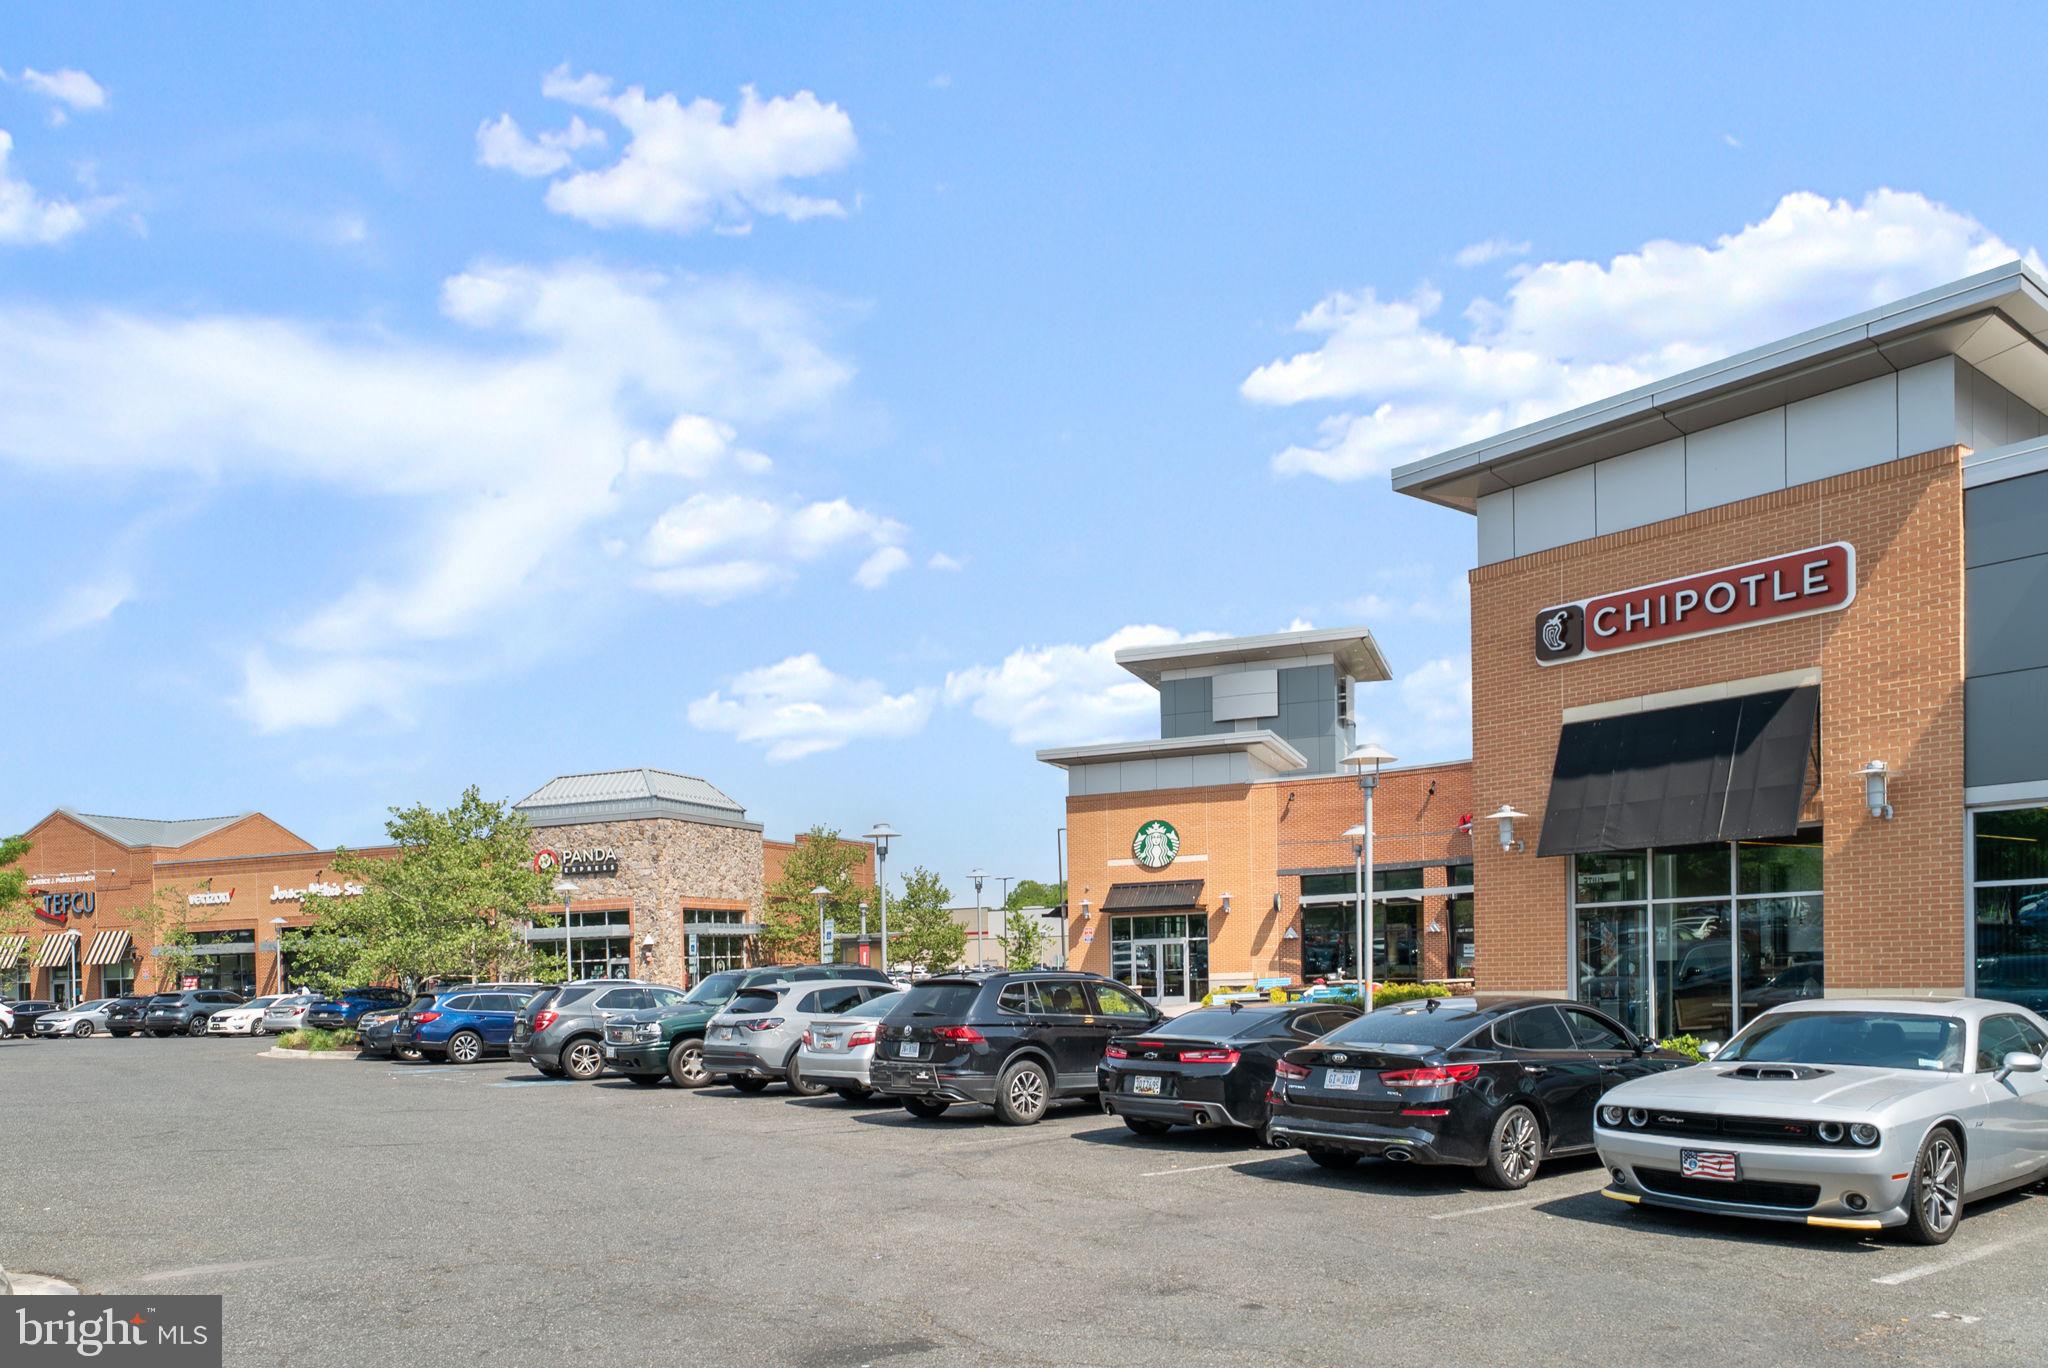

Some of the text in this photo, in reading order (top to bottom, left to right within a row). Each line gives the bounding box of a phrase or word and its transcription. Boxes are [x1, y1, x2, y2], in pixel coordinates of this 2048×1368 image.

[1592, 558, 1830, 637] CHIPOTLE
[562, 847, 617, 864] PANDA
[564, 864, 615, 874] EXPRESS
[43, 891, 95, 915] TEFCU
[188, 892, 231, 905] verizon
